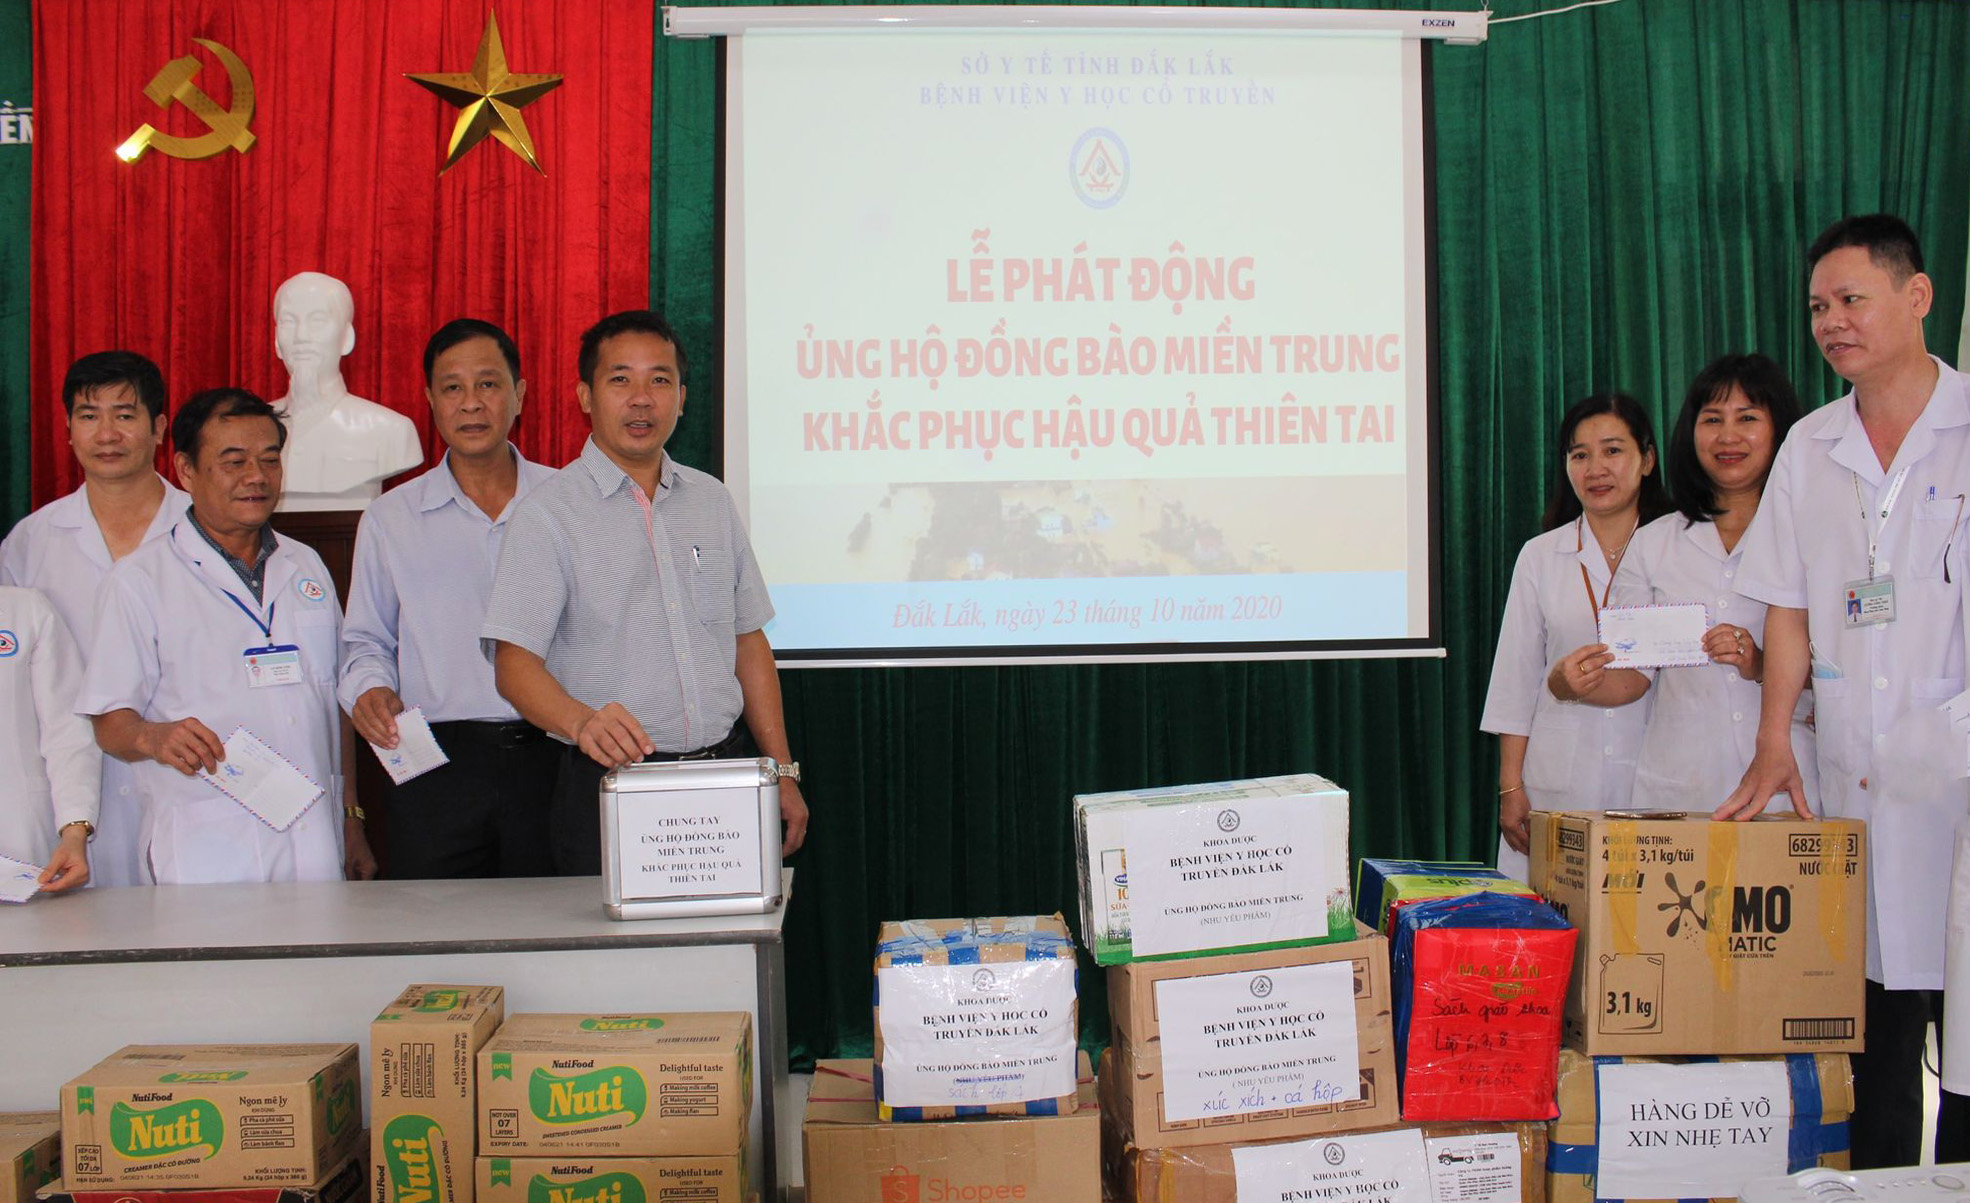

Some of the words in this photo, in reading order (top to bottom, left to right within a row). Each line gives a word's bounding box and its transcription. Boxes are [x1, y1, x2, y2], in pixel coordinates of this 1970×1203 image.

[961, 52, 989, 75] SỞ
[1001, 57, 1013, 75] Y
[1025, 49, 1053, 75] TẾ
[1064, 51, 1120, 75] TỈNH
[1131, 49, 1177, 75] ĐẮK
[1189, 49, 1234, 75] LẮK
[920, 83, 982, 109] BỆNH
[994, 82, 1049, 109] VIỆN
[1060, 87, 1073, 105] Y
[1084, 86, 1131, 109] HỌC
[1143, 75, 1172, 105] CỔ
[1184, 80, 1276, 105] TRUYỀN
[946, 228, 994, 302] LỄ
[1003, 241, 1120, 302] PHÁT
[1128, 240, 1255, 315] ĐỘNG
[796, 323, 881, 379] ỦNG
[890, 323, 947, 390] HỘ
[954, 317, 1068, 377] ĐỒNG
[1077, 322, 1157, 376] BÀO
[1163, 315, 1262, 375] MIỀN
[1269, 333, 1400, 374] TRUNG
[803, 389, 911, 452] KHẮC
[918, 409, 1024, 461] PHỤC
[1032, 393, 1114, 460] HẬU
[1122, 391, 1205, 457] QUẢ
[1211, 391, 1327, 445] THIÊN
[1335, 405, 1395, 444] TAI
[892, 599, 935, 629] Đắk
[943, 598, 987, 629] Lắk,
[995, 603, 1045, 632] ngày
[1052, 599, 1078, 625] 23
[1084, 597, 1142, 629] tháng
[1151, 596, 1174, 622] 10
[1180, 598, 1225, 622] năm
[1231, 595, 1283, 621] 2020
[658, 817, 697, 827] CHUNG
[700, 816, 720, 825] TAY
[1203, 838, 1229, 848] KHOA
[1652, 836, 1673, 848] TỊNH:
[1792, 838, 1854, 852] 682993
[688, 846, 725, 855] TRUNG
[1236, 850, 1244, 860] Y
[1247, 848, 1272, 860] HỌC
[1602, 849, 1609, 861] 4
[1640, 849, 1656, 863] 3,1
[1660, 848, 1694, 865] kg/túi
[1274, 894, 1304, 904] TRUNG
[1459, 965, 1540, 978] MASAN
[957, 998, 984, 1006] KHOA
[1606, 991, 1631, 1016] 3,1
[1636, 997, 1652, 1017] kg
[1236, 1005, 1262, 1014] KHOA
[1269, 1016, 1278, 1026] Y
[1280, 1013, 1306, 1026] HỌC
[552, 1060, 594, 1068] NutiFood
[1028, 1055, 1058, 1067] TRUNG
[1307, 1055, 1336, 1066] TRUNG
[660, 1064, 702, 1074] Delightful
[704, 1064, 723, 1072] taste
[382, 1074, 393, 1097] Ngon
[132, 1093, 173, 1102] NutiFood
[239, 1096, 262, 1107] Ngon
[264, 1096, 277, 1105] mê
[547, 1076, 624, 1117] Nuti
[1631, 1098, 1697, 1121] HÀNG
[1704, 1097, 1733, 1120] DỄ
[1740, 1096, 1771, 1118] VỠ
[128, 1109, 202, 1151] Nuti
[1628, 1130, 1668, 1147] XIN
[1675, 1128, 1722, 1149] NHẸ
[1728, 1126, 1773, 1145] TAY
[78, 1162, 89, 1171] 07
[551, 1166, 593, 1175] NutiFood
[660, 1169, 702, 1179] Delightful
[704, 1169, 723, 1177] taste
[1313, 1173, 1337, 1181] KHOA
[928, 1178, 1026, 1203] Shopee
[1345, 1186, 1353, 1195] Y
